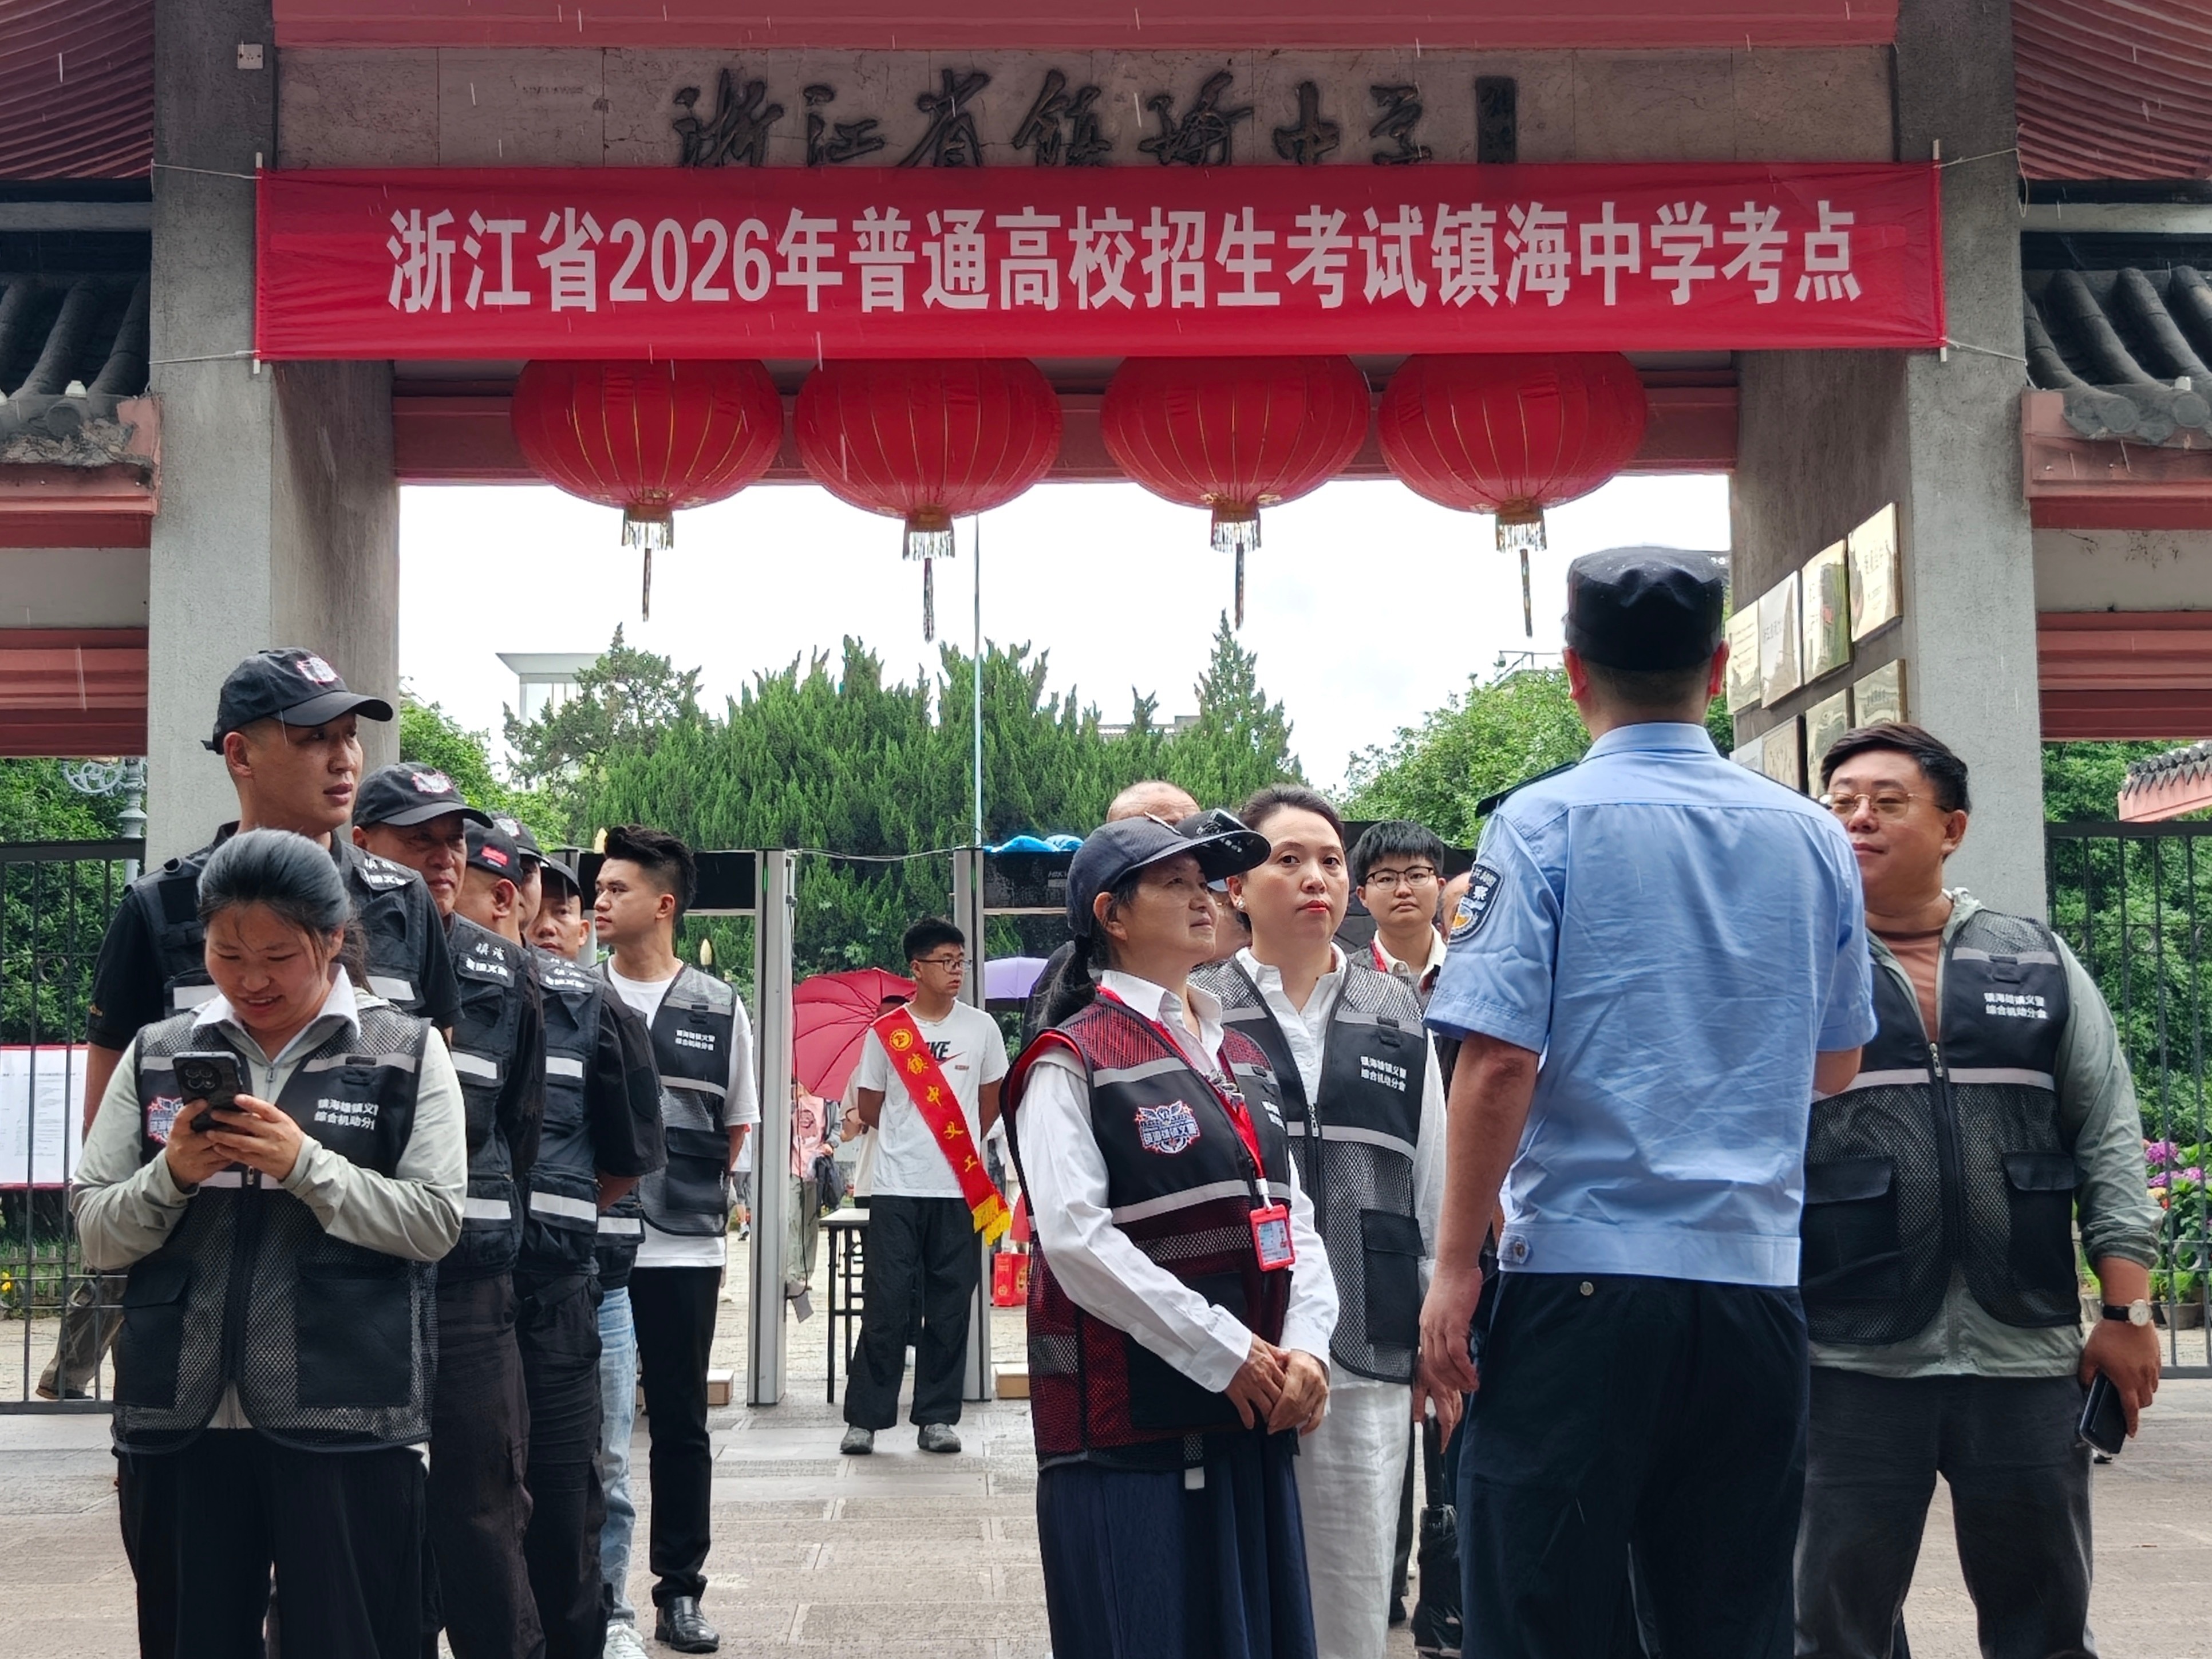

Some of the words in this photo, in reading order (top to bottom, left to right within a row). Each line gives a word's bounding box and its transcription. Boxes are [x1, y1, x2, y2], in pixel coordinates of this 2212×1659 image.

[386, 200, 1862, 313] 浙江省2026年普通高校招生考试镇海中学考点
